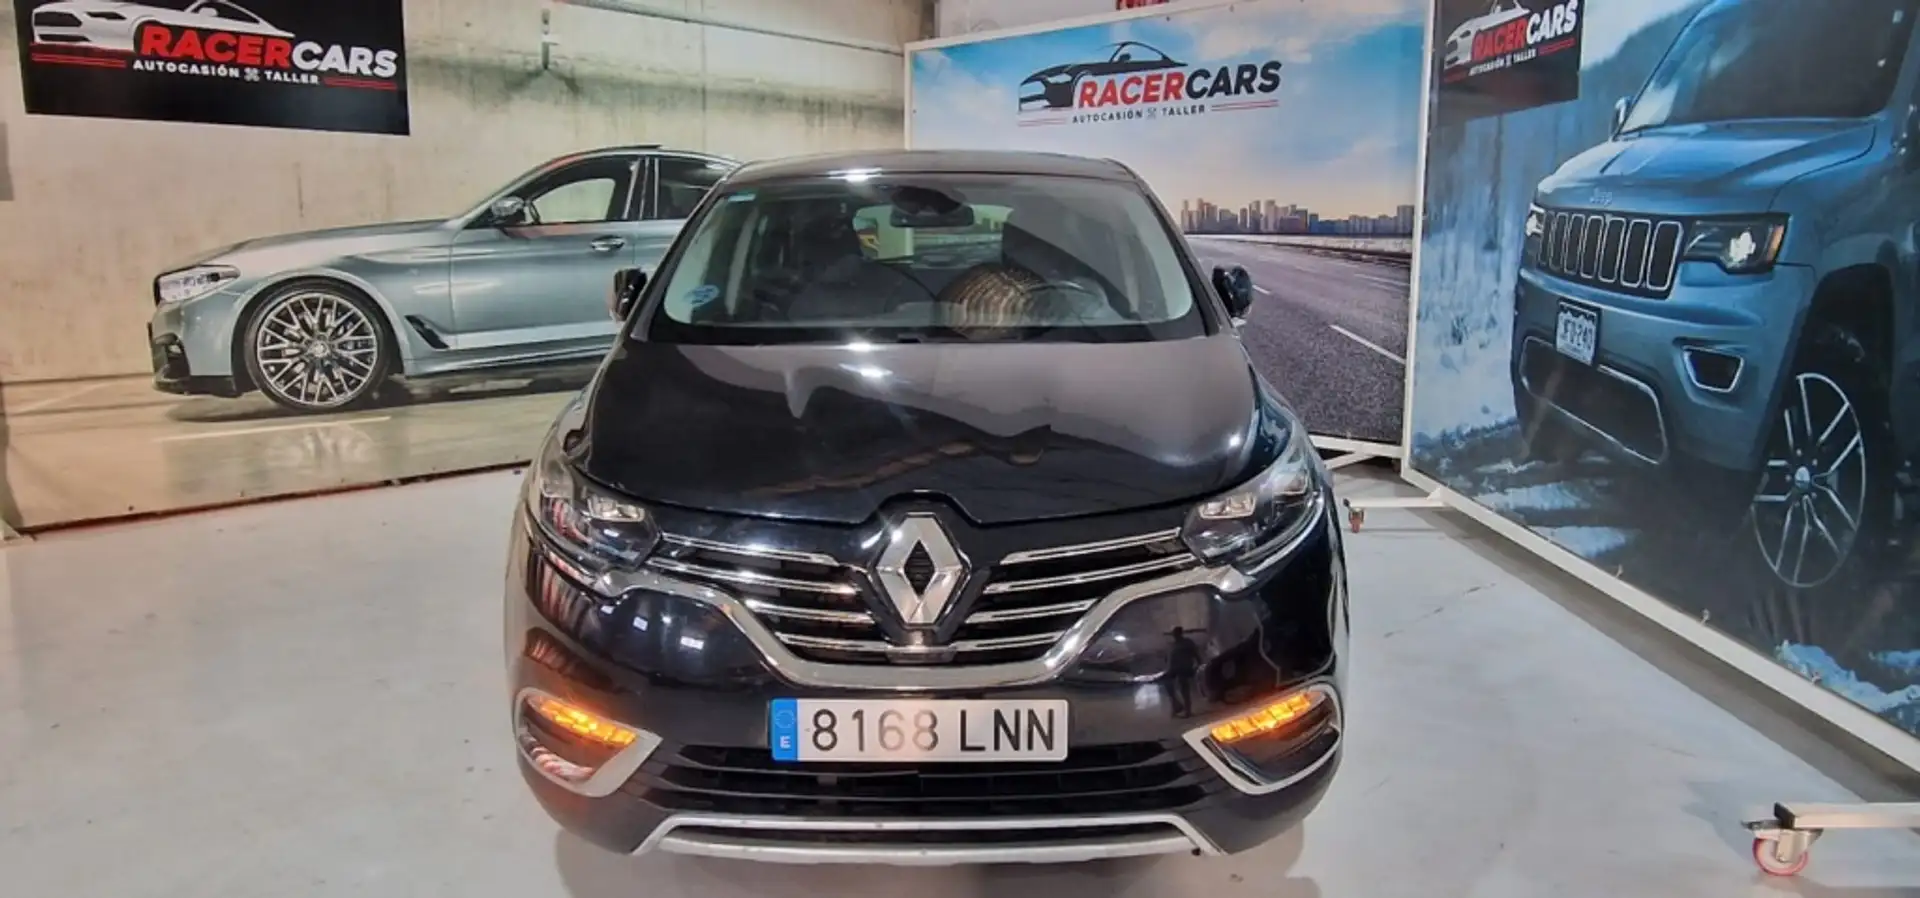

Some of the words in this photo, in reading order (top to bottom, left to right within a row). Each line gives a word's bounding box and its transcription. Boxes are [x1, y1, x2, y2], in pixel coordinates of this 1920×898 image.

[141, 26, 398, 78] RACERCARS
[133, 60, 240, 78] AUTOCASIÓN
[264, 70, 320, 85] TALLER
[1078, 60, 1282, 109] RACERCARS
[1162, 103, 1206, 117] TALLER
[779, 735, 791, 749] E
[812, 708, 939, 752] 8168
[959, 708, 1055, 752] LNN
